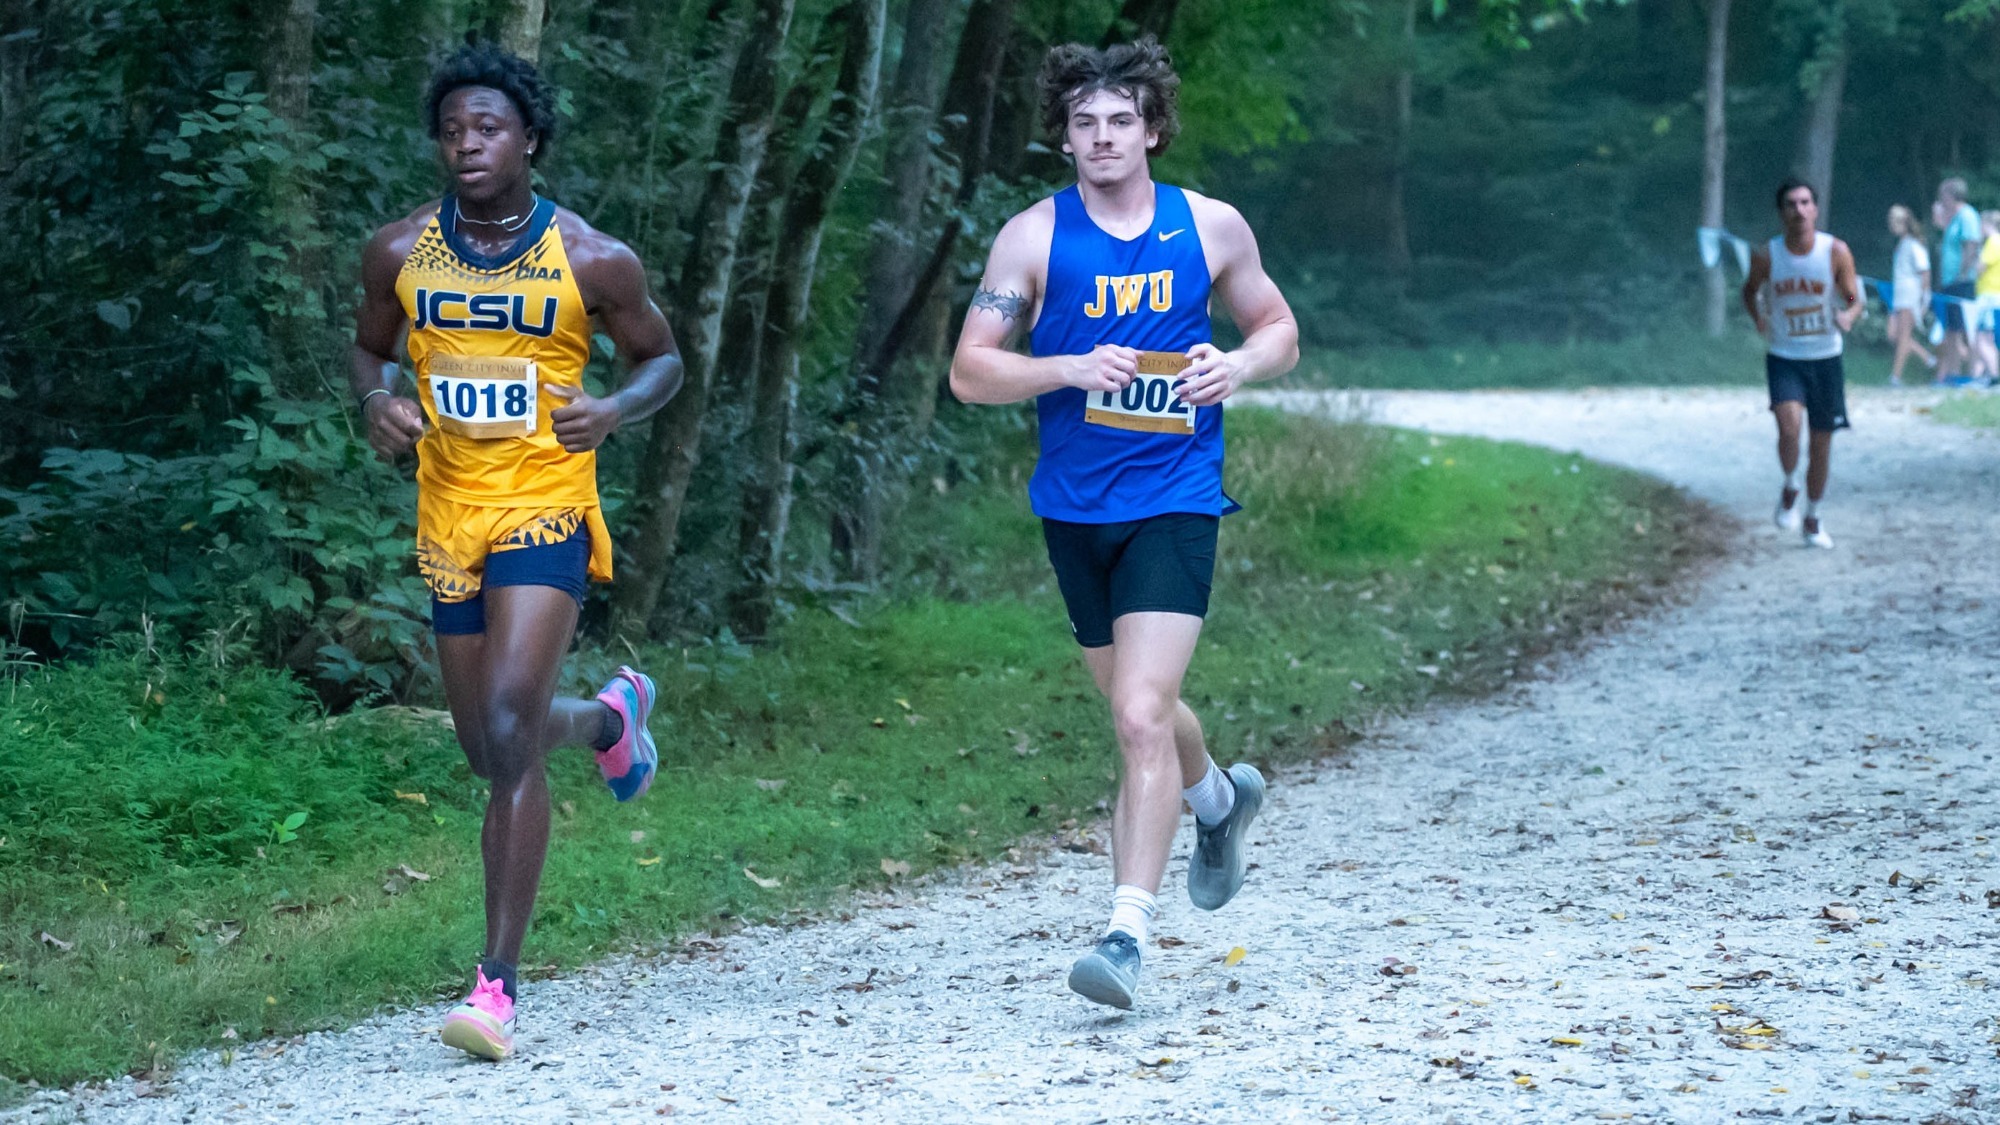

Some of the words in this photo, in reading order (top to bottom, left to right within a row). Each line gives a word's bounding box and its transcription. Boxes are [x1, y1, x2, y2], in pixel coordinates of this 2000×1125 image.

[515, 266, 562, 282] CIAA
[1084, 270, 1174, 318] JWU
[1775, 278, 1825, 297] SHAW
[414, 288, 558, 338] JCSU
[432, 360, 463, 372] QUEEN
[468, 363, 491, 373] CITY
[1140, 359, 1162, 368] CITY
[436, 380, 527, 418] 1018
